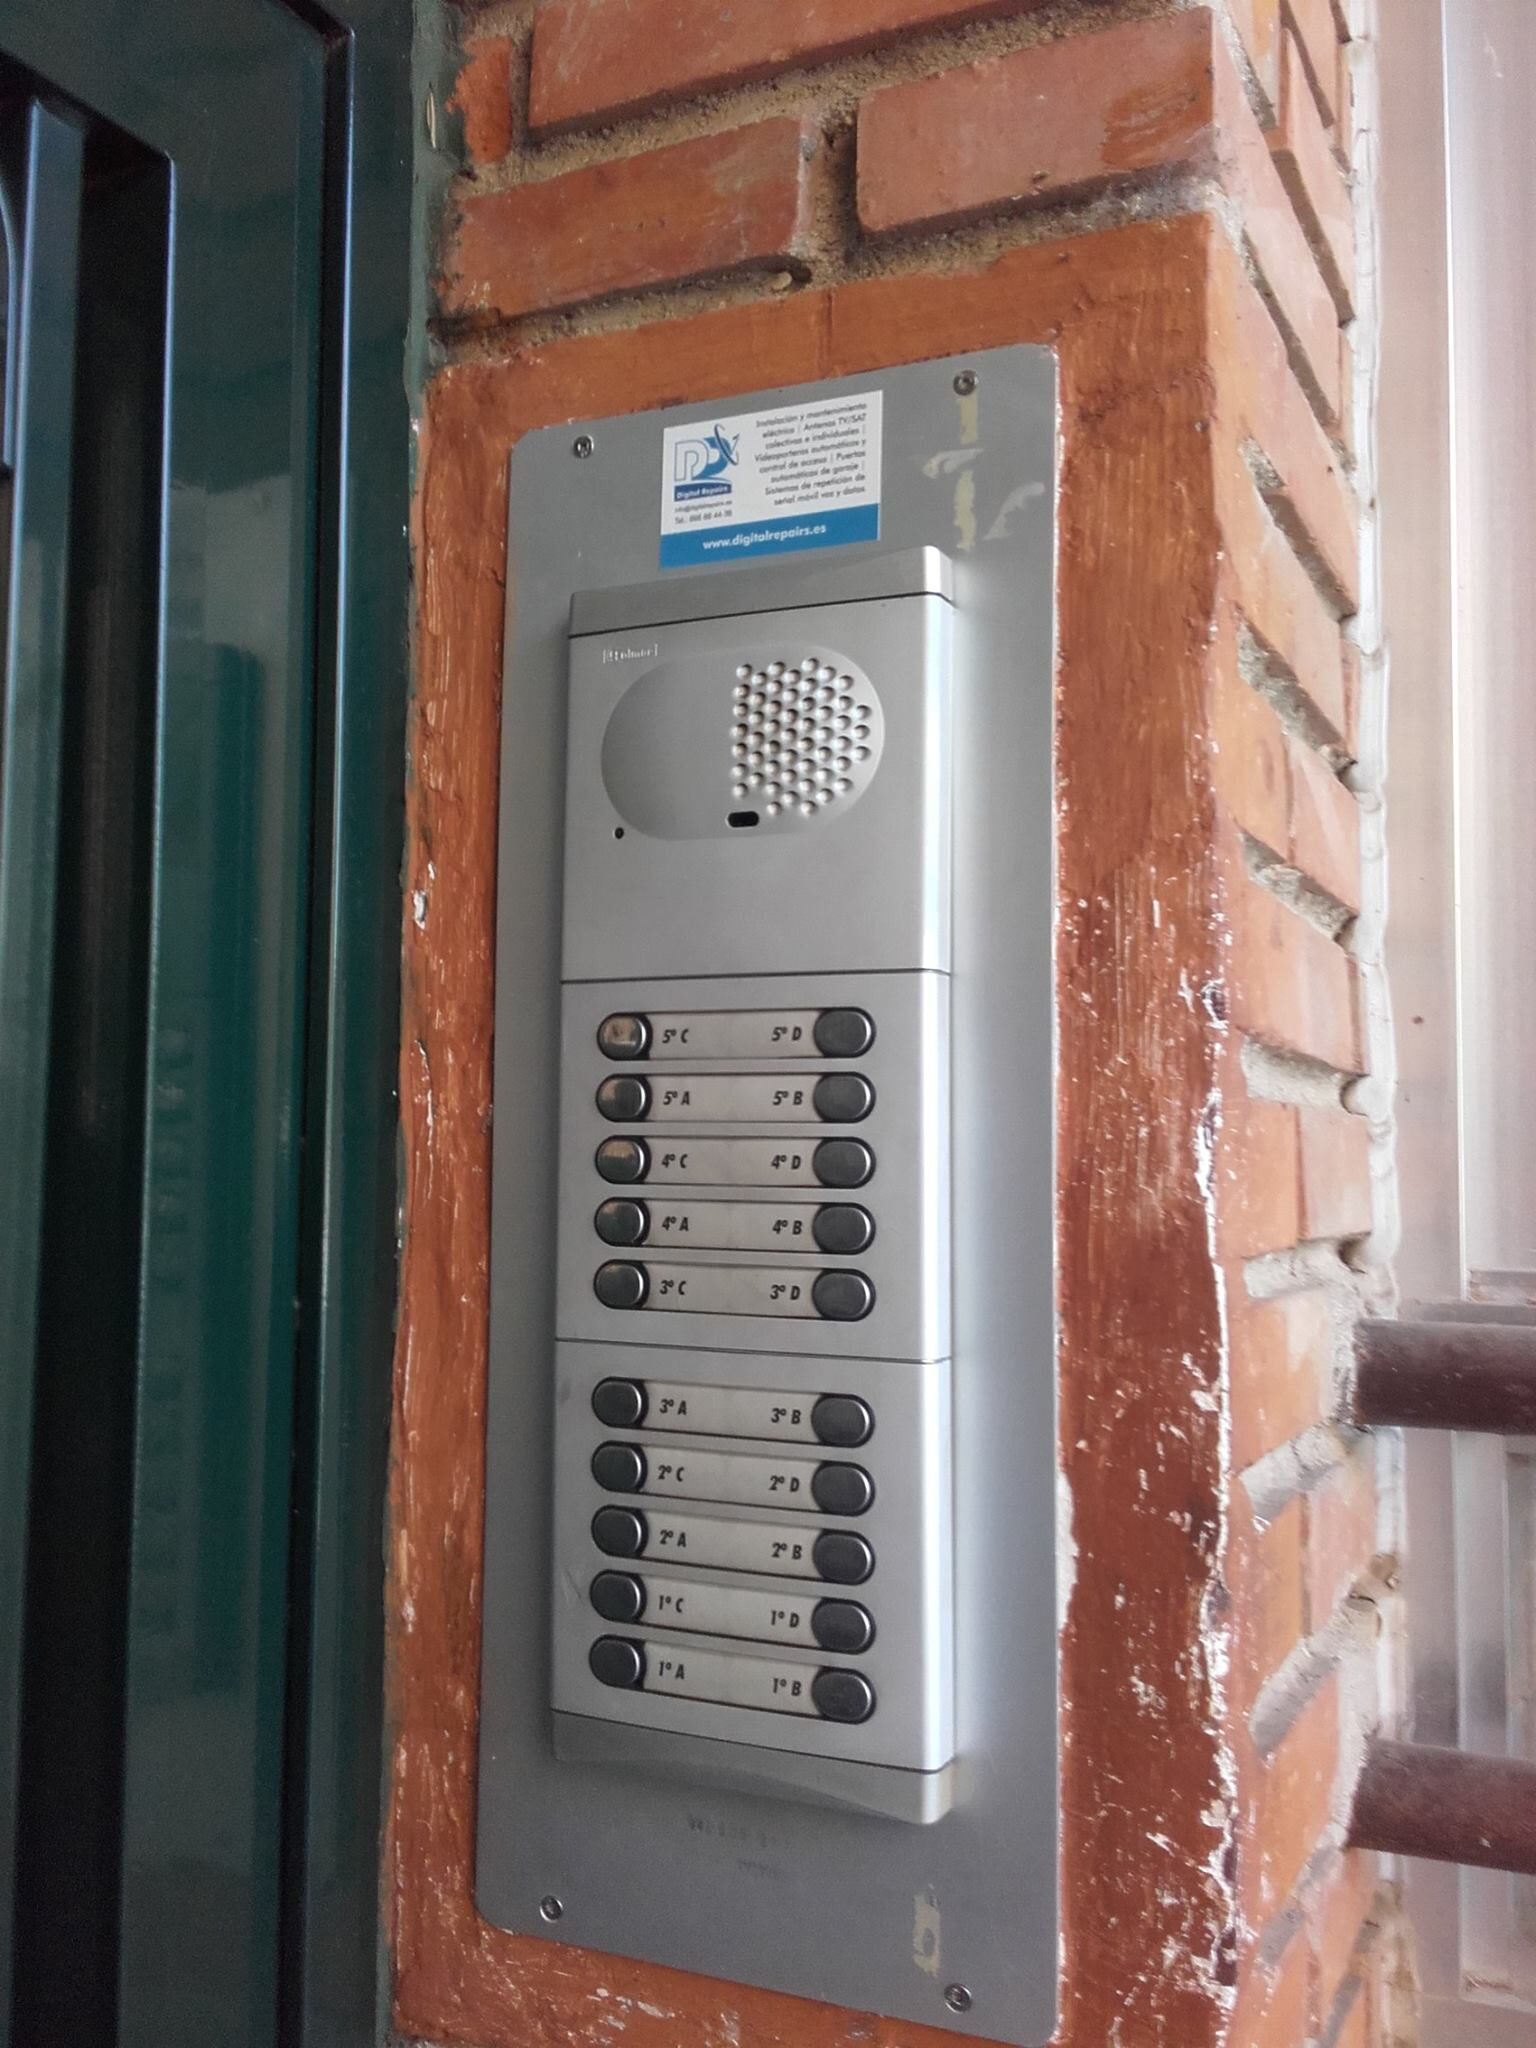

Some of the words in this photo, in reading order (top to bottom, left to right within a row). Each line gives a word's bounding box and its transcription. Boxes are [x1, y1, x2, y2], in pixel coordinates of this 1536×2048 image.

[702, 524, 827, 550] www.digitalrepairs.es
[680, 1028, 689, 1043] C
[792, 1026, 802, 1041] D
[681, 1091, 691, 1105] A
[793, 1091, 804, 1105] B
[679, 1153, 688, 1168] C
[792, 1155, 801, 1170] D
[679, 1217, 689, 1232] A
[792, 1220, 803, 1235] B
[678, 1280, 687, 1295] C
[791, 1286, 800, 1300] D
[677, 1401, 687, 1415] A
[791, 1410, 801, 1425] B
[676, 1467, 685, 1482] C
[789, 1477, 799, 1492] D
[677, 1532, 687, 1547] A
[792, 1545, 802, 1560] B
[675, 1598, 684, 1613] C
[789, 1613, 799, 1628] D
[675, 1664, 685, 1680] A
[792, 1681, 802, 1696] B
